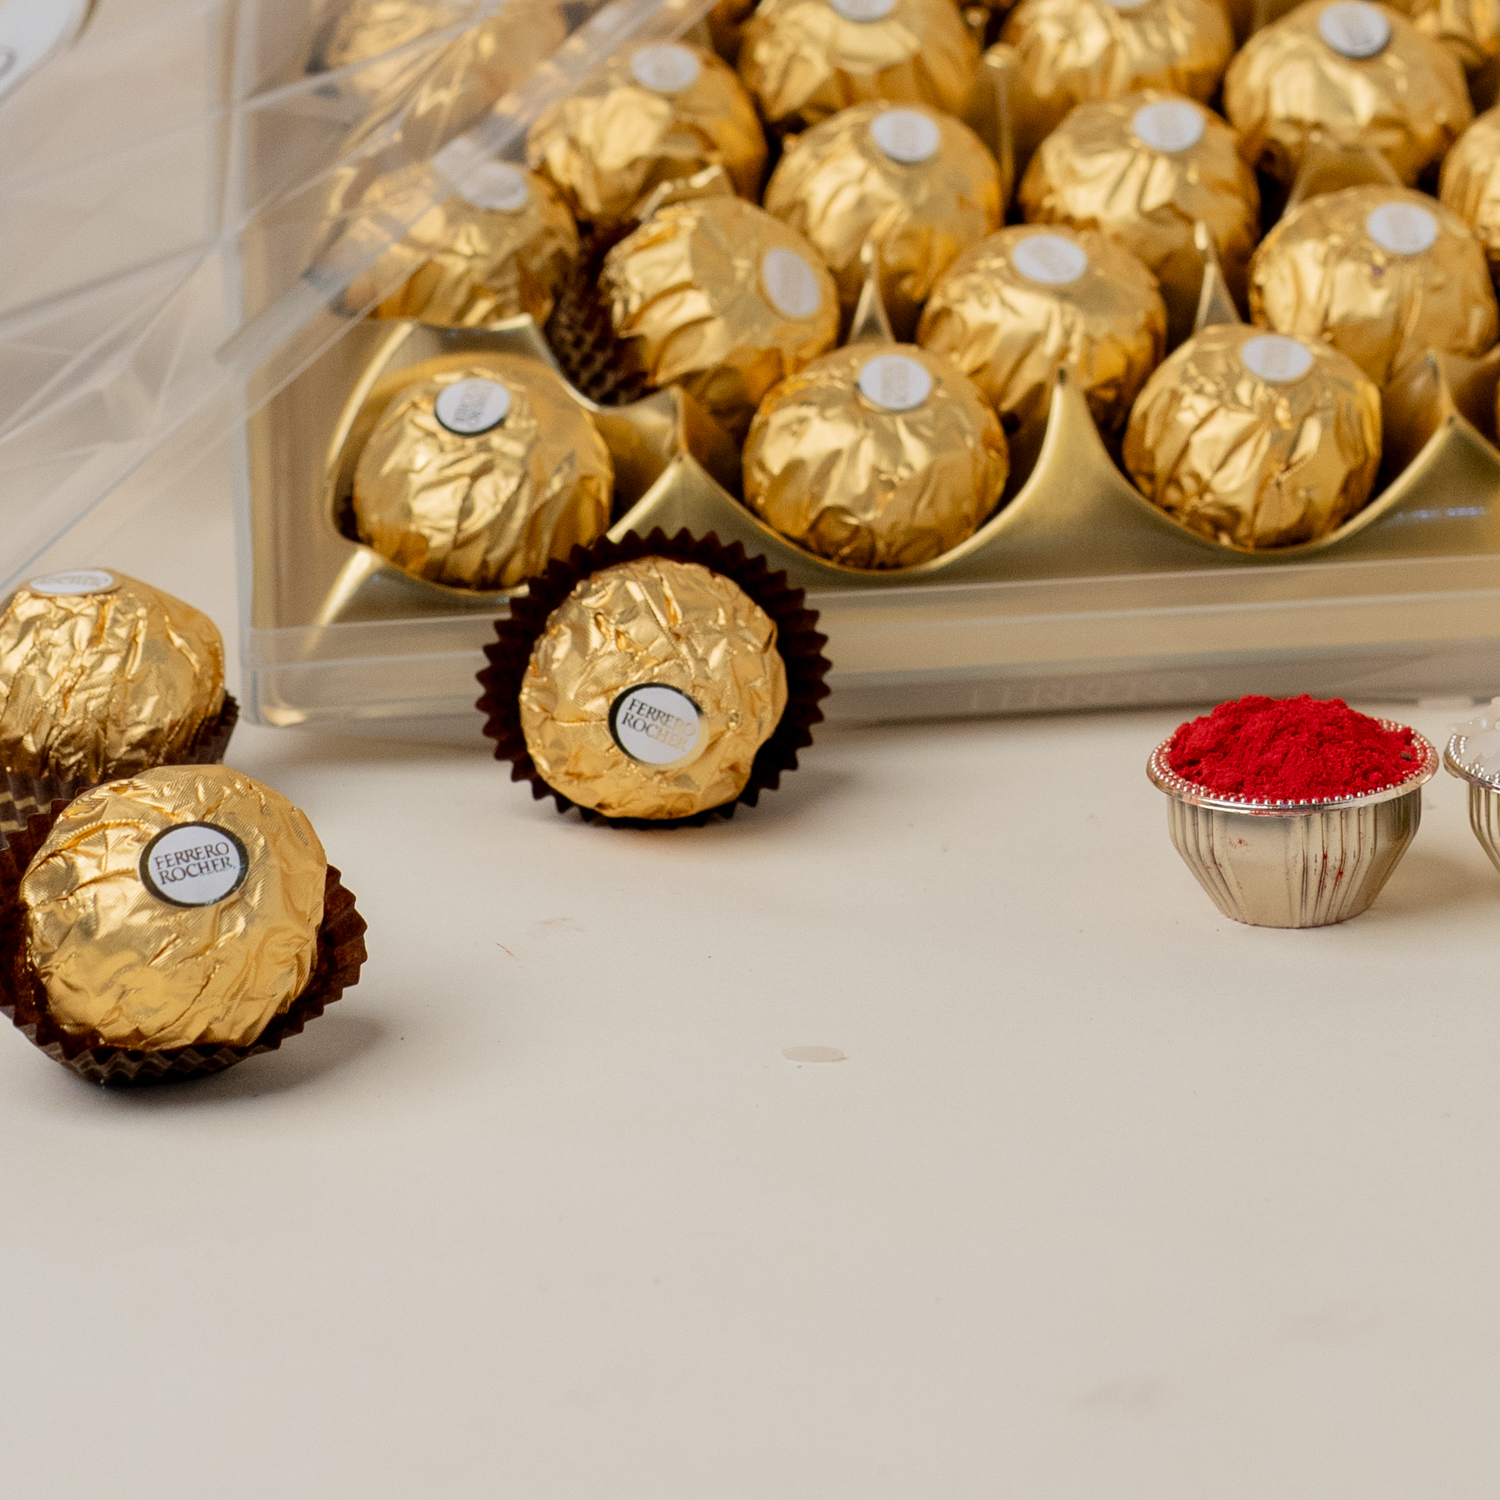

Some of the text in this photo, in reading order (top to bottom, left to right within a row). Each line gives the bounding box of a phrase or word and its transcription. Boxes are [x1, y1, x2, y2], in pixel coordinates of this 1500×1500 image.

[621, 711, 687, 752] ROCHER
[628, 698, 696, 737] FERRERO
[153, 841, 230, 871] FERRERO
[158, 856, 233, 885] ROCHER
